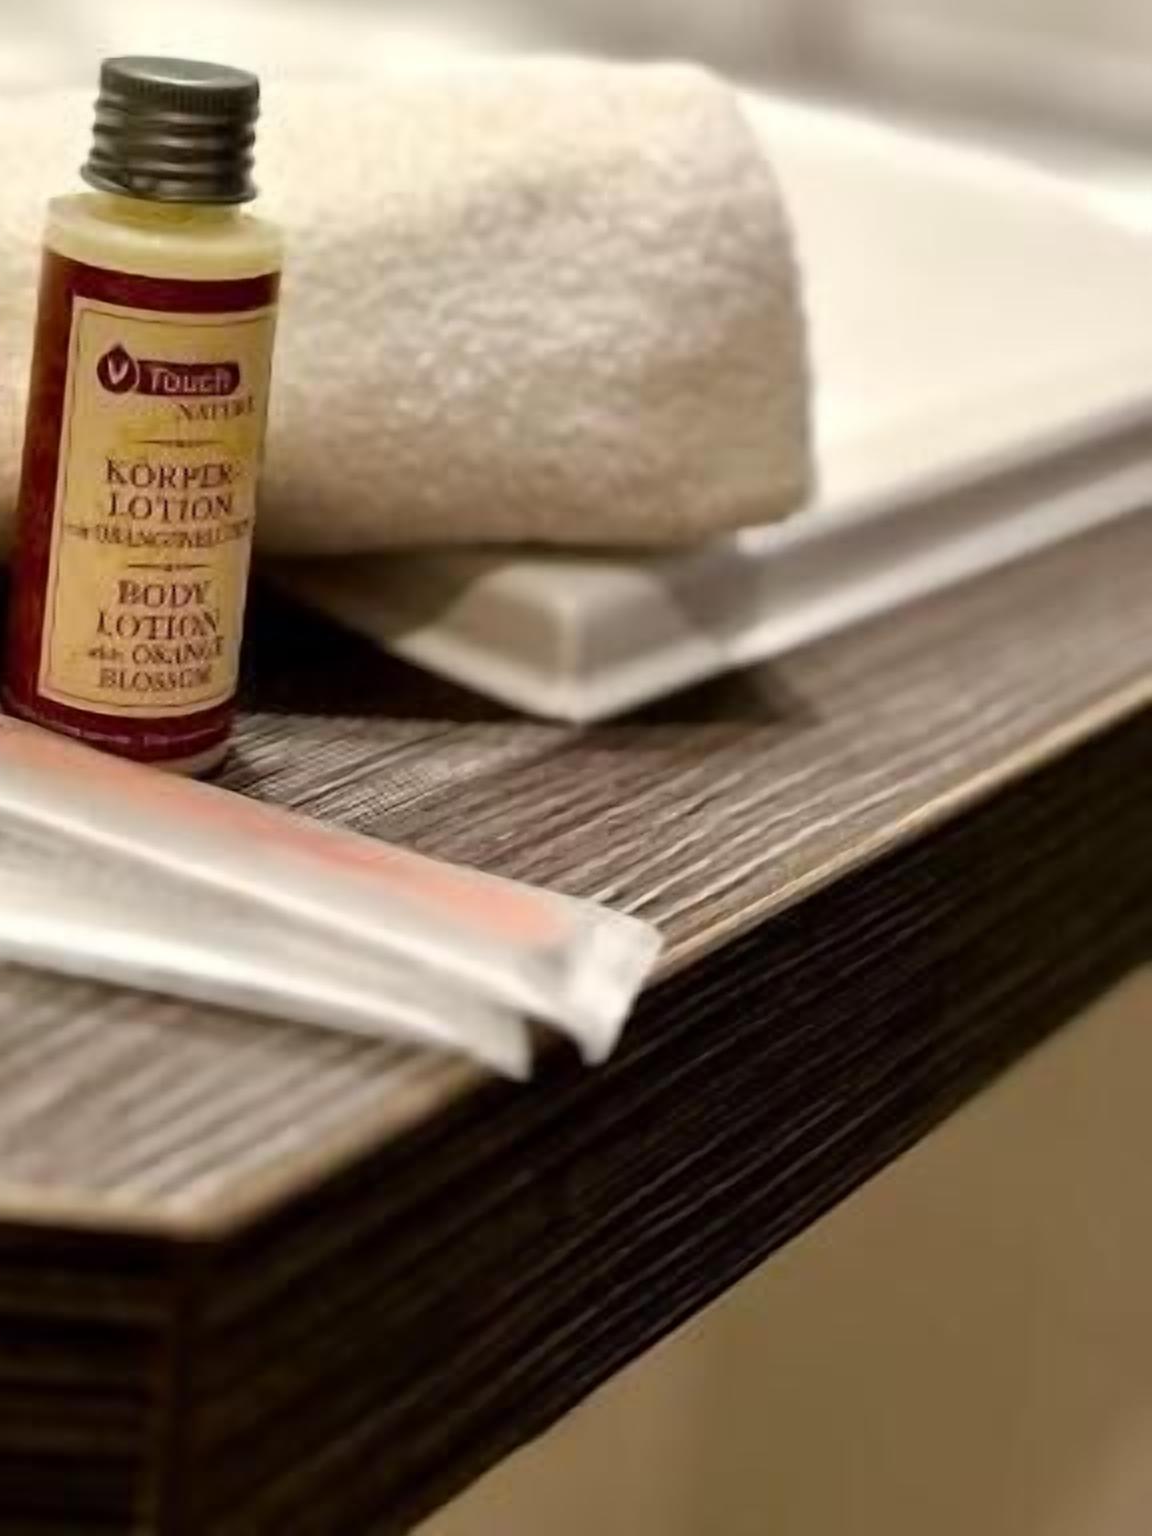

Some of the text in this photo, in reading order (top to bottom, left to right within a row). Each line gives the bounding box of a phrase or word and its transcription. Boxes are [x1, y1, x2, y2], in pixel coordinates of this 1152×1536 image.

[108, 492, 233, 523] LOTION
[118, 579, 212, 608] BODY
[96, 609, 221, 640] LOTION
